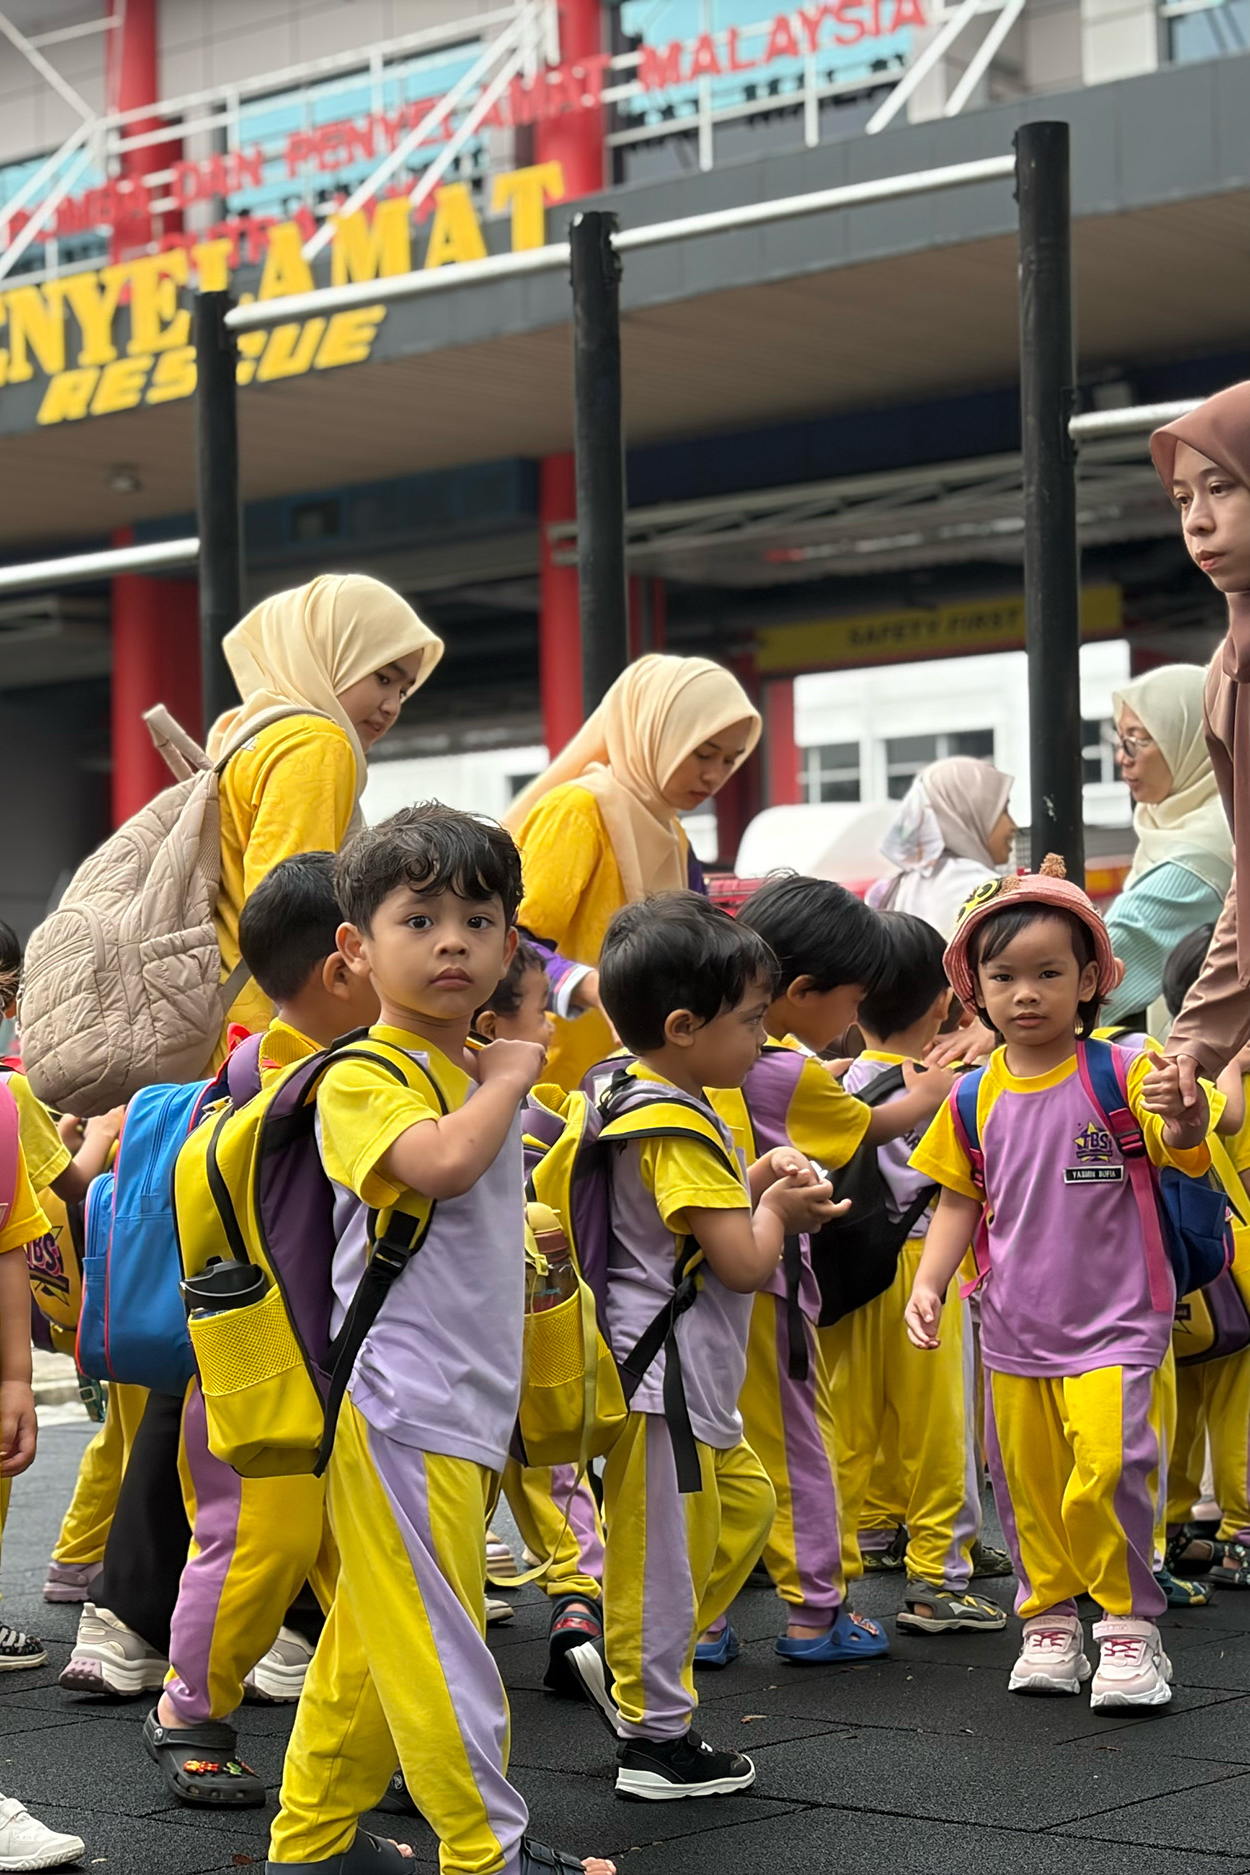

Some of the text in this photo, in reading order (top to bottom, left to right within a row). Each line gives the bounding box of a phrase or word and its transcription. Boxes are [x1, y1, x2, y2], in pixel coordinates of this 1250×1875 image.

[172, 142, 264, 210] DAN
[637, 0, 927, 92] MALAYSIA
[850, 607, 1021, 647] SAFETY FIRST
[1081, 1131, 1110, 1151] TBS
[27, 1231, 61, 1275] BS
